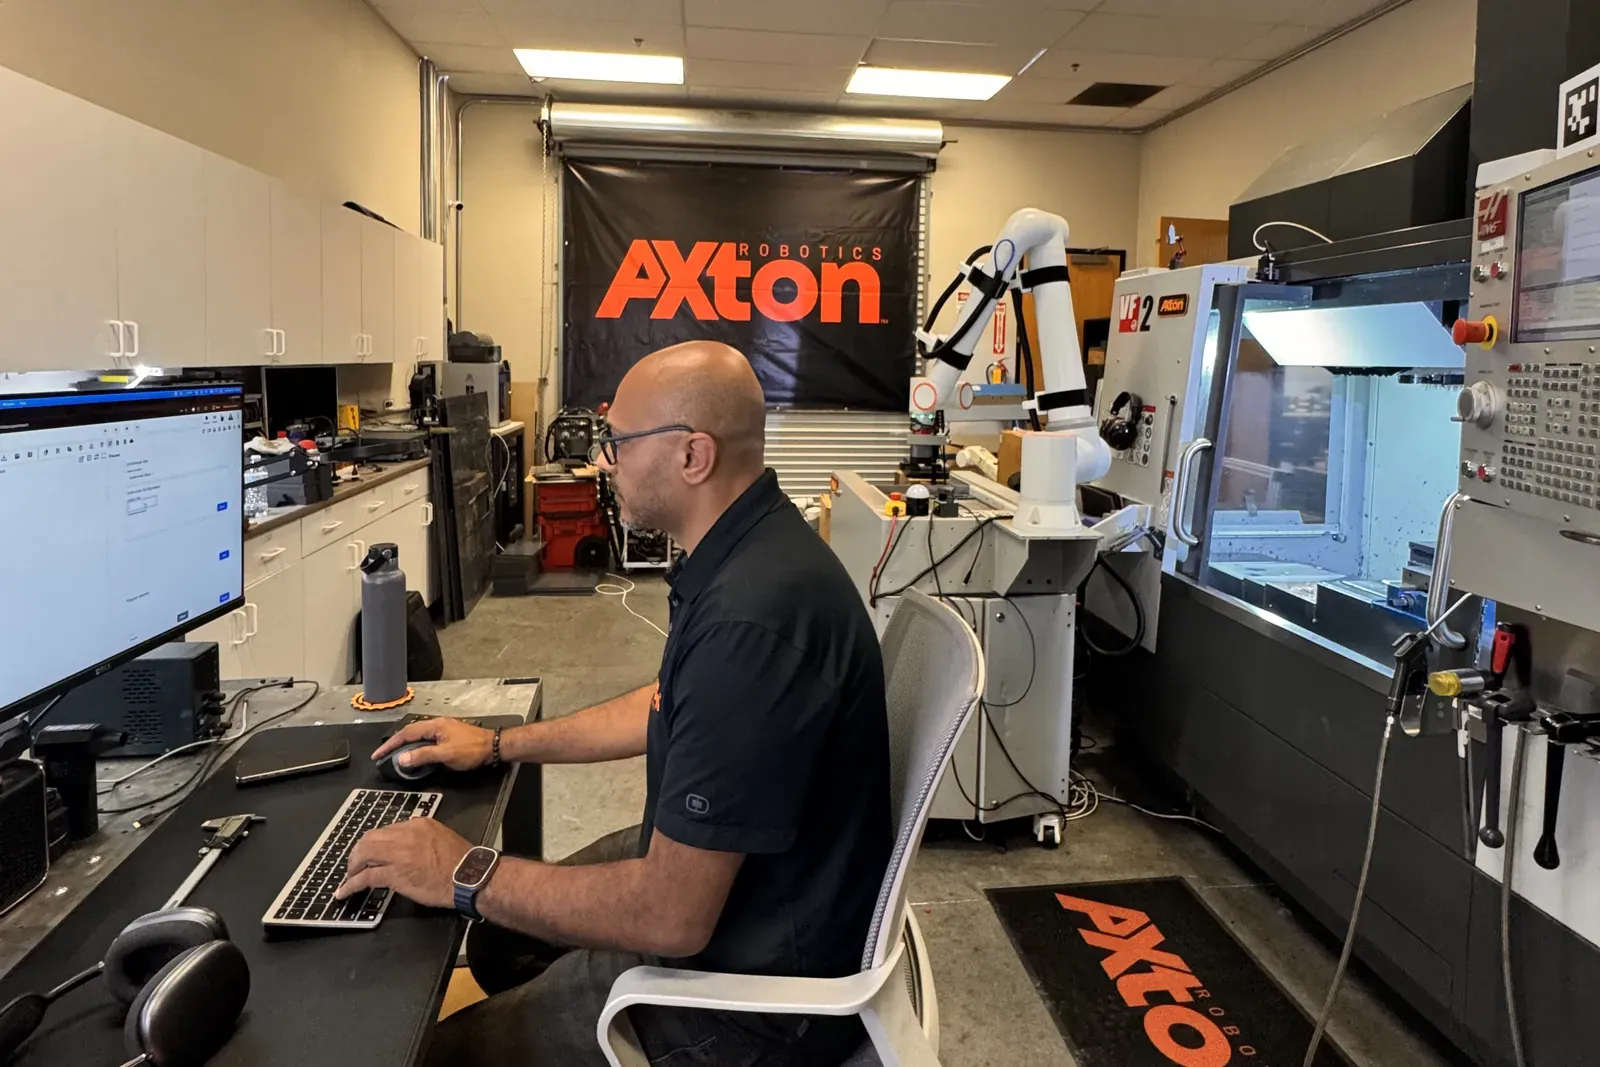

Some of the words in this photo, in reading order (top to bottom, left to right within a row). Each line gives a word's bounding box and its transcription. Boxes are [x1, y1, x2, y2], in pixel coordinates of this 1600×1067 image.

[740, 243, 882, 260] ROBOTICS
[1120, 293, 1138, 320] VF
[1140, 295, 1154, 332] 2
[1194, 989, 1257, 1056] ROBO
